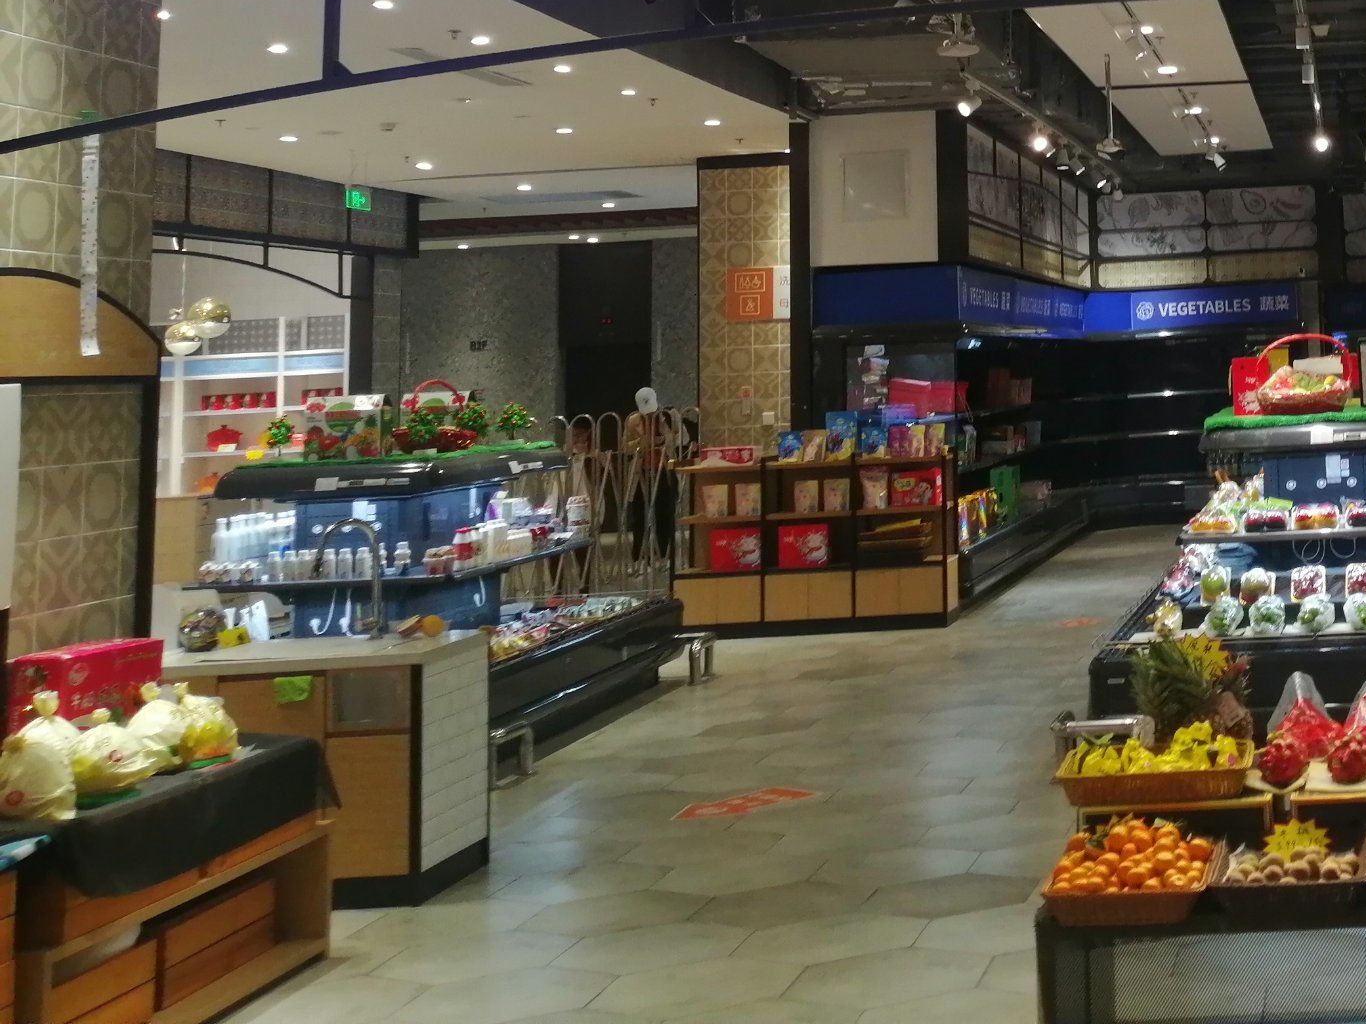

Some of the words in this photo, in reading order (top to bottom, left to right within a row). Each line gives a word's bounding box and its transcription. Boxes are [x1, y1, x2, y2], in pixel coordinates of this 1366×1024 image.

[970, 287, 999, 309] VEGETABLES
[1158, 296, 1251, 317] VEGETABLES
[1260, 295, 1289, 312] 蔬菜
